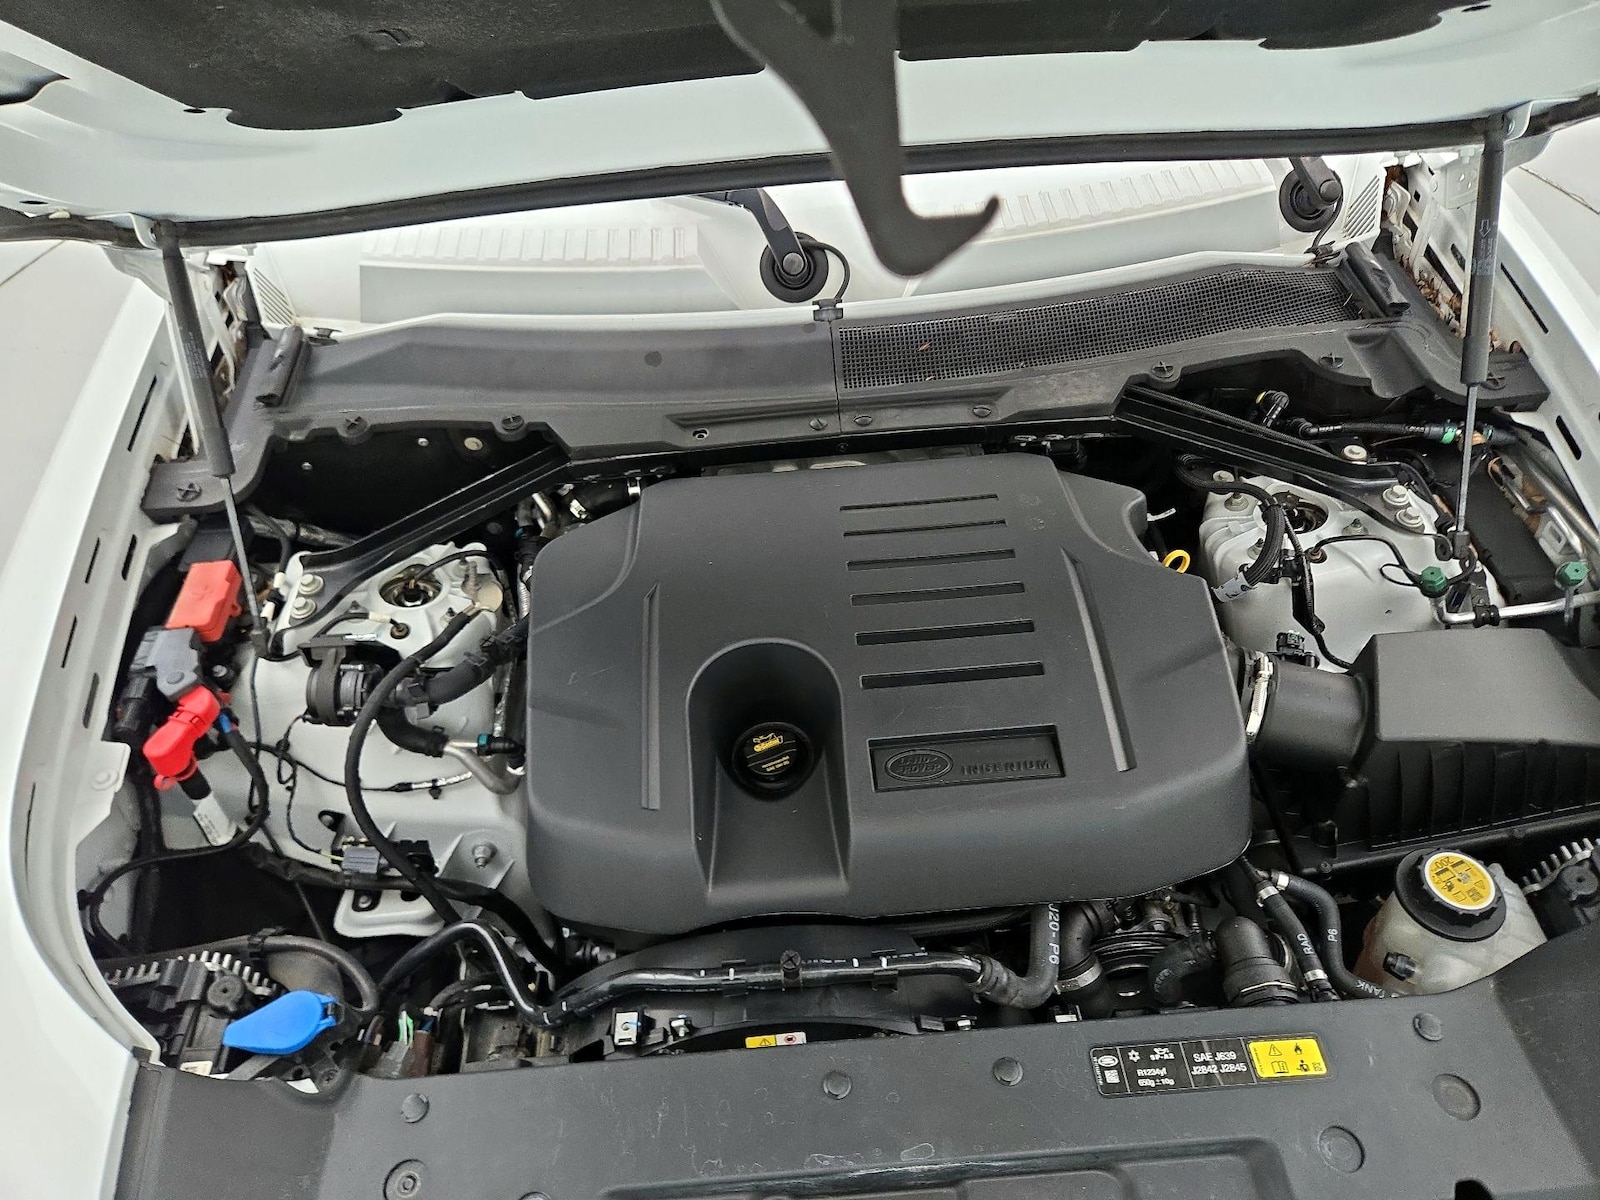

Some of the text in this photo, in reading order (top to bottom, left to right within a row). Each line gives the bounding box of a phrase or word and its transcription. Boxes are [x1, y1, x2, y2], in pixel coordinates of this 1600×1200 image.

[1327, 928, 1339, 942] P6
[1296, 933, 1315, 955] RAD
[1192, 1050, 1237, 1063] SAE J639
[1190, 1062, 1248, 1075] J2842 J2845
